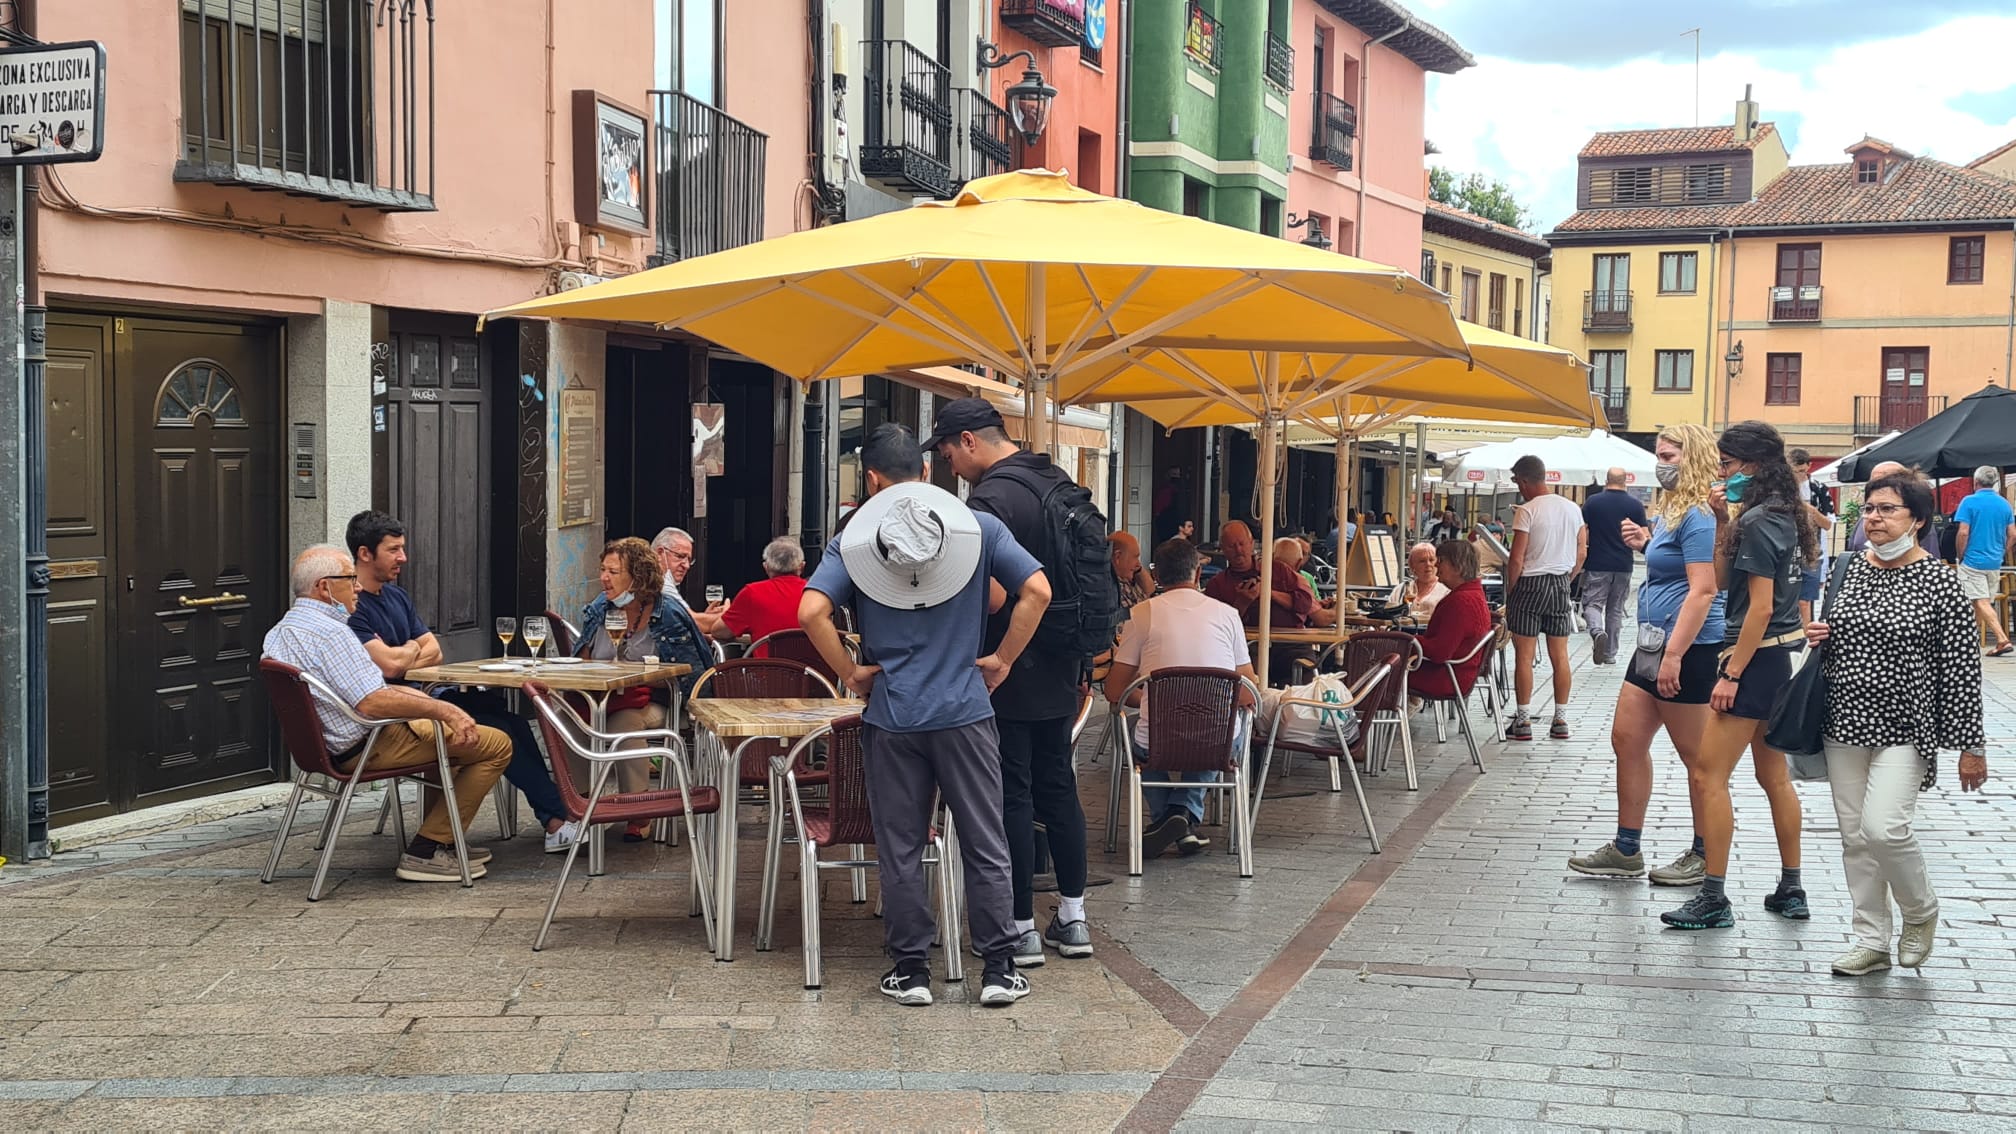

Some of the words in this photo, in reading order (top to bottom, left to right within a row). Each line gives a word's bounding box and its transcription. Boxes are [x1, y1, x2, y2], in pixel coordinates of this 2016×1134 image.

[0, 64, 25, 85] ONA
[30, 58, 90, 83] EXCLUSIVA
[29, 92, 38, 114] Y
[42, 88, 92, 112] DESCARGA
[116, 319, 122, 332] 2
